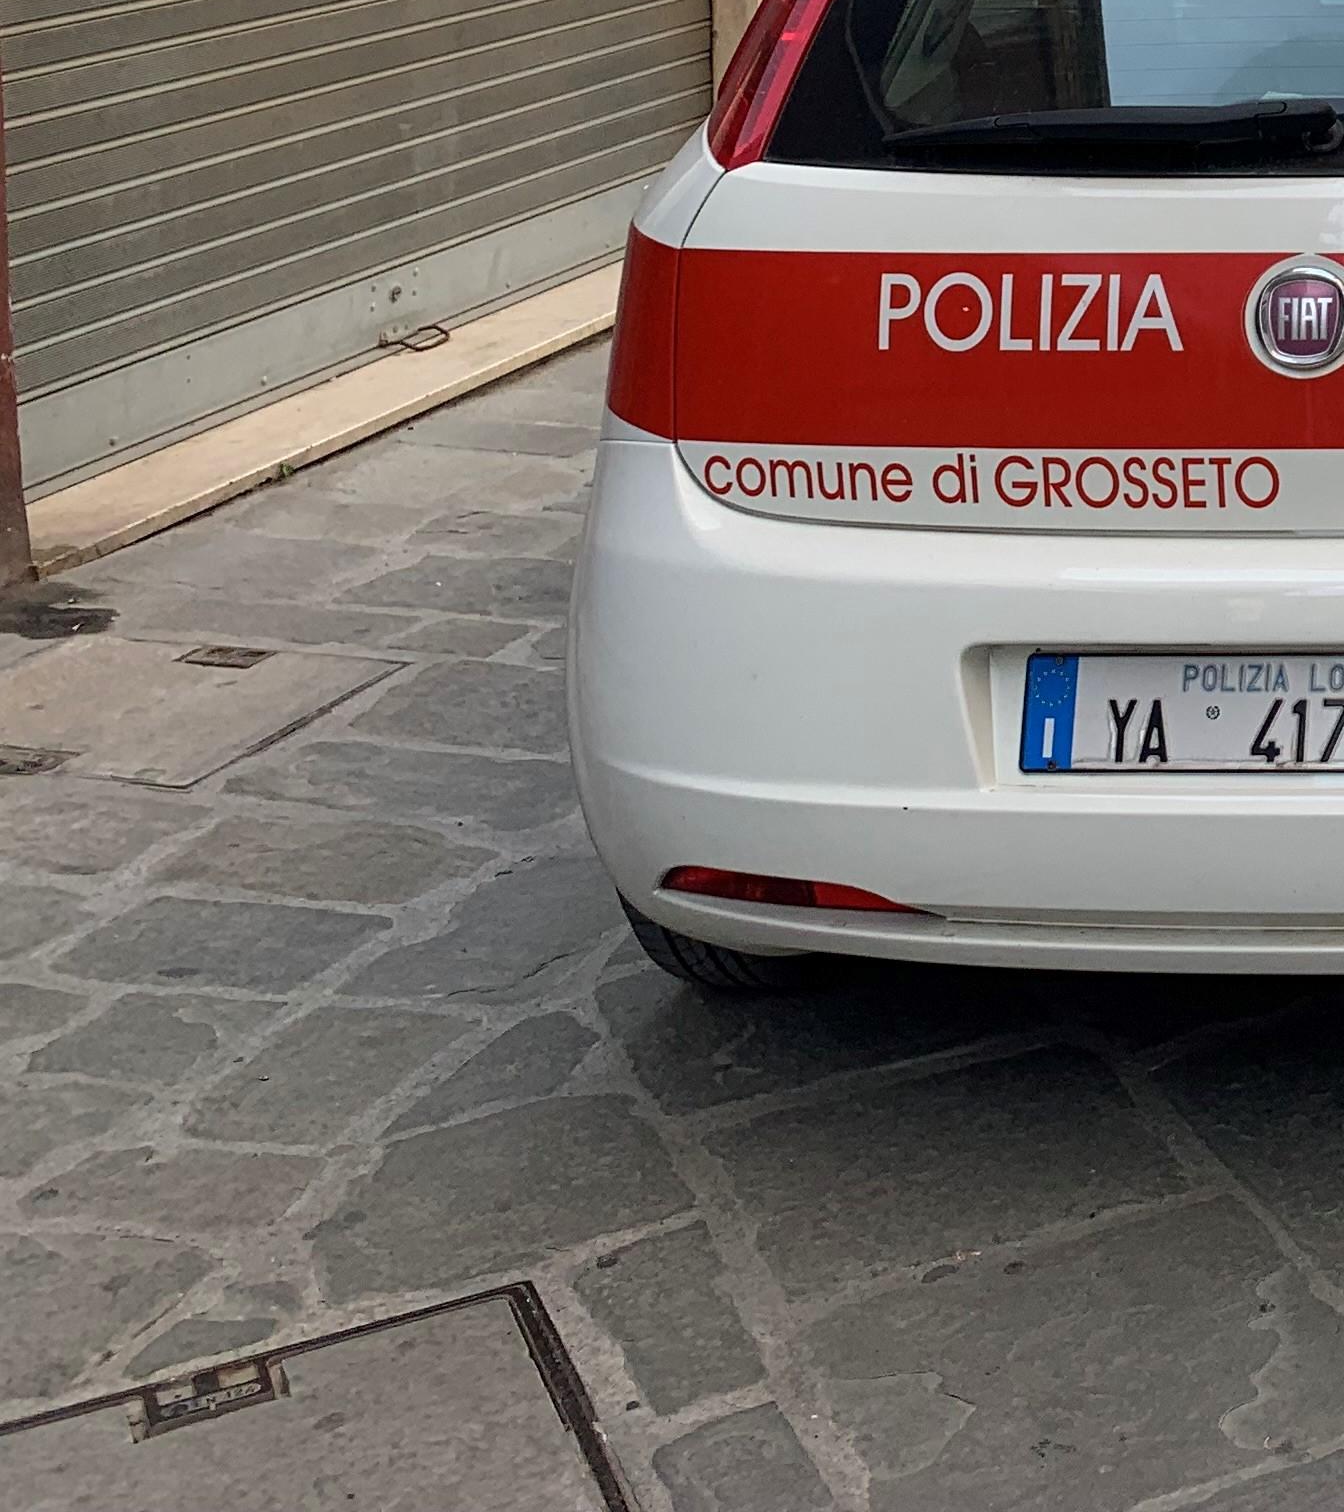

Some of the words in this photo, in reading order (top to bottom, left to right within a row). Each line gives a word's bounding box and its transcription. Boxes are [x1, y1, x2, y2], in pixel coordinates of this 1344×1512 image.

[877, 271, 1184, 352] POLIZIA
[1276, 296, 1334, 342] FIAT
[703, 454, 914, 504] comune
[932, 452, 980, 505] di
[993, 454, 1281, 509] GROSSETO
[1181, 662, 1290, 694] POLIZIA
[1107, 698, 1169, 764] YA
